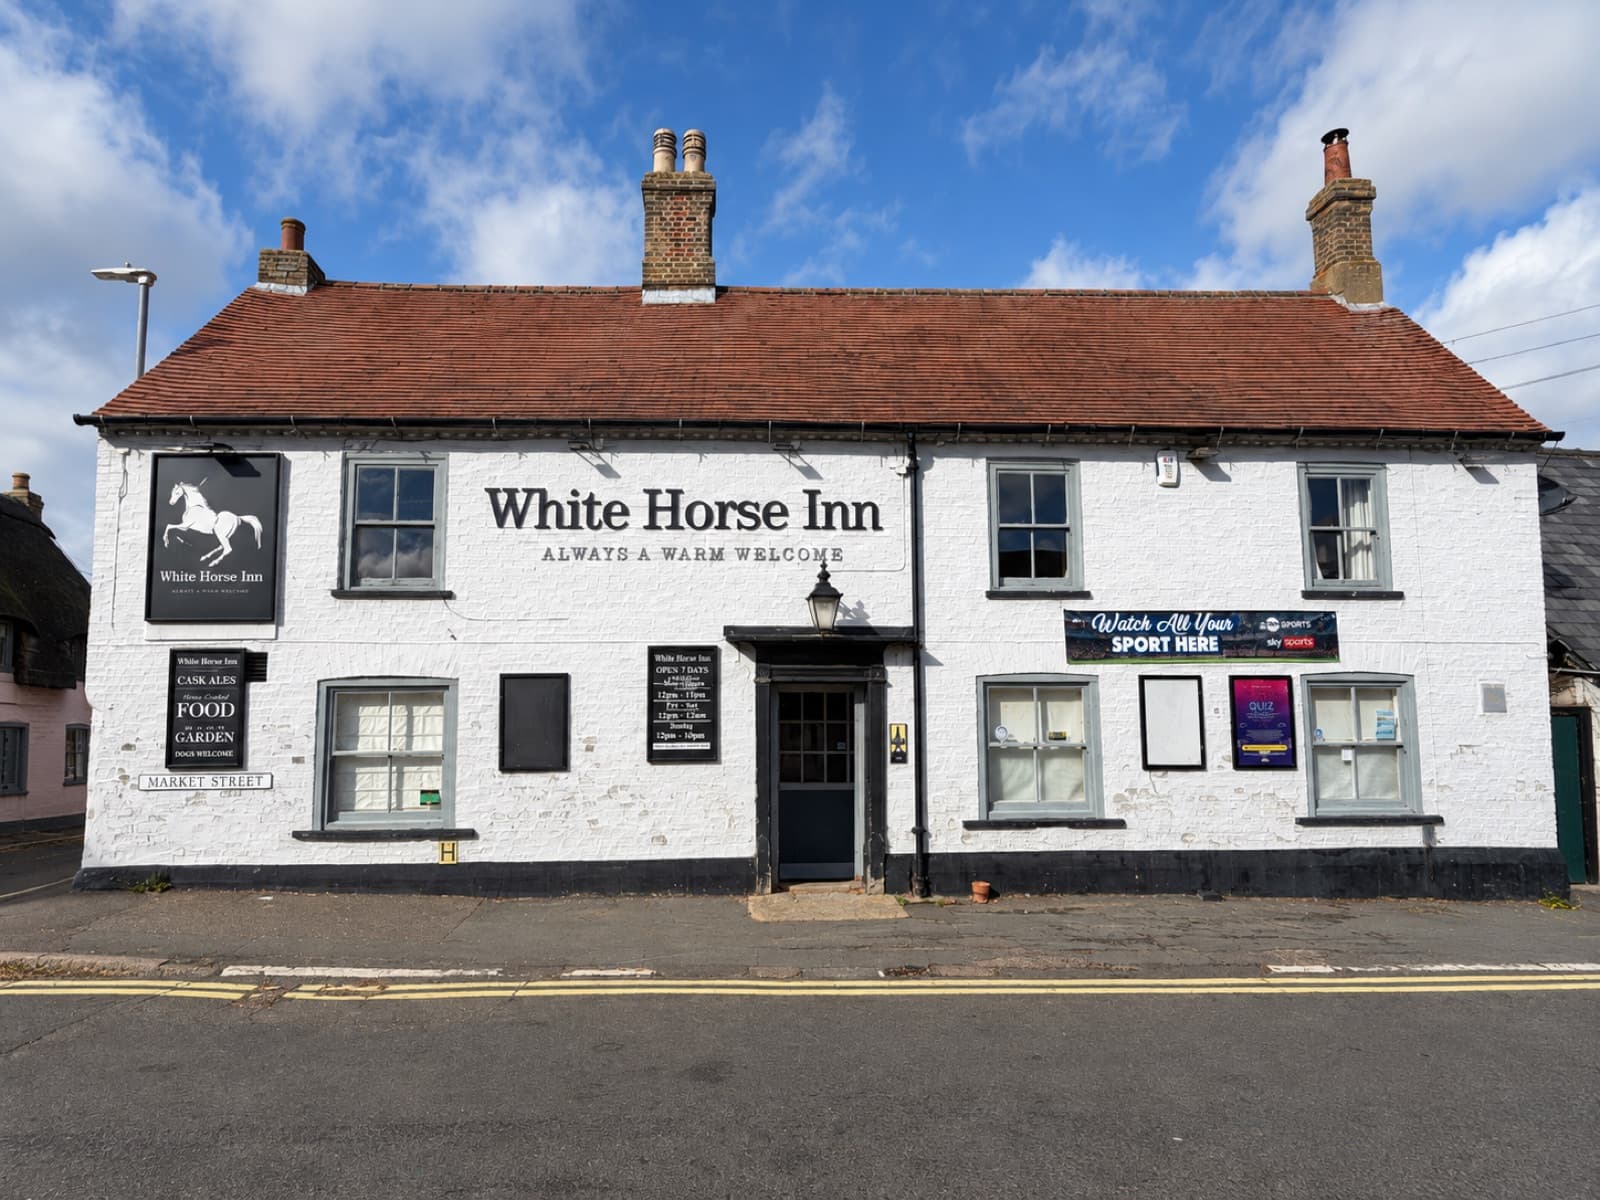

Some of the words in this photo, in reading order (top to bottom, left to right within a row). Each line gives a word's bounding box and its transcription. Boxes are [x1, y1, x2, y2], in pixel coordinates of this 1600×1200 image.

[484, 487, 630, 530] White
[642, 488, 790, 531] Horse
[802, 488, 884, 532] Inn
[541, 547, 628, 561] ALWAYS
[638, 547, 651, 561] A
[661, 547, 725, 561] WARM
[736, 546, 844, 561] WELCOME
[160, 570, 196, 582] White
[200, 570, 238, 582] Horse
[241, 570, 264, 582] Inn
[1091, 613, 1151, 632] Watch
[1156, 613, 1191, 635] All
[1194, 613, 1234, 637] Your
[1111, 637, 1169, 654] SPORT
[1173, 636, 1219, 653] HERE
[1266, 637, 1282, 649] sky
[656, 666, 679, 674] OPEN
[687, 666, 709, 674] DAYS
[177, 675, 206, 685] CASK
[208, 675, 237, 685] ALES
[176, 701, 236, 718] FOOD
[1249, 701, 1274, 713] QUIZ
[175, 731, 235, 743] GARDEN
[175, 750, 195, 758] DOGS
[197, 749, 234, 757] WELCOME
[148, 776, 205, 788] MARKET
[211, 775, 264, 787] STREET
[441, 842, 455, 862] H
